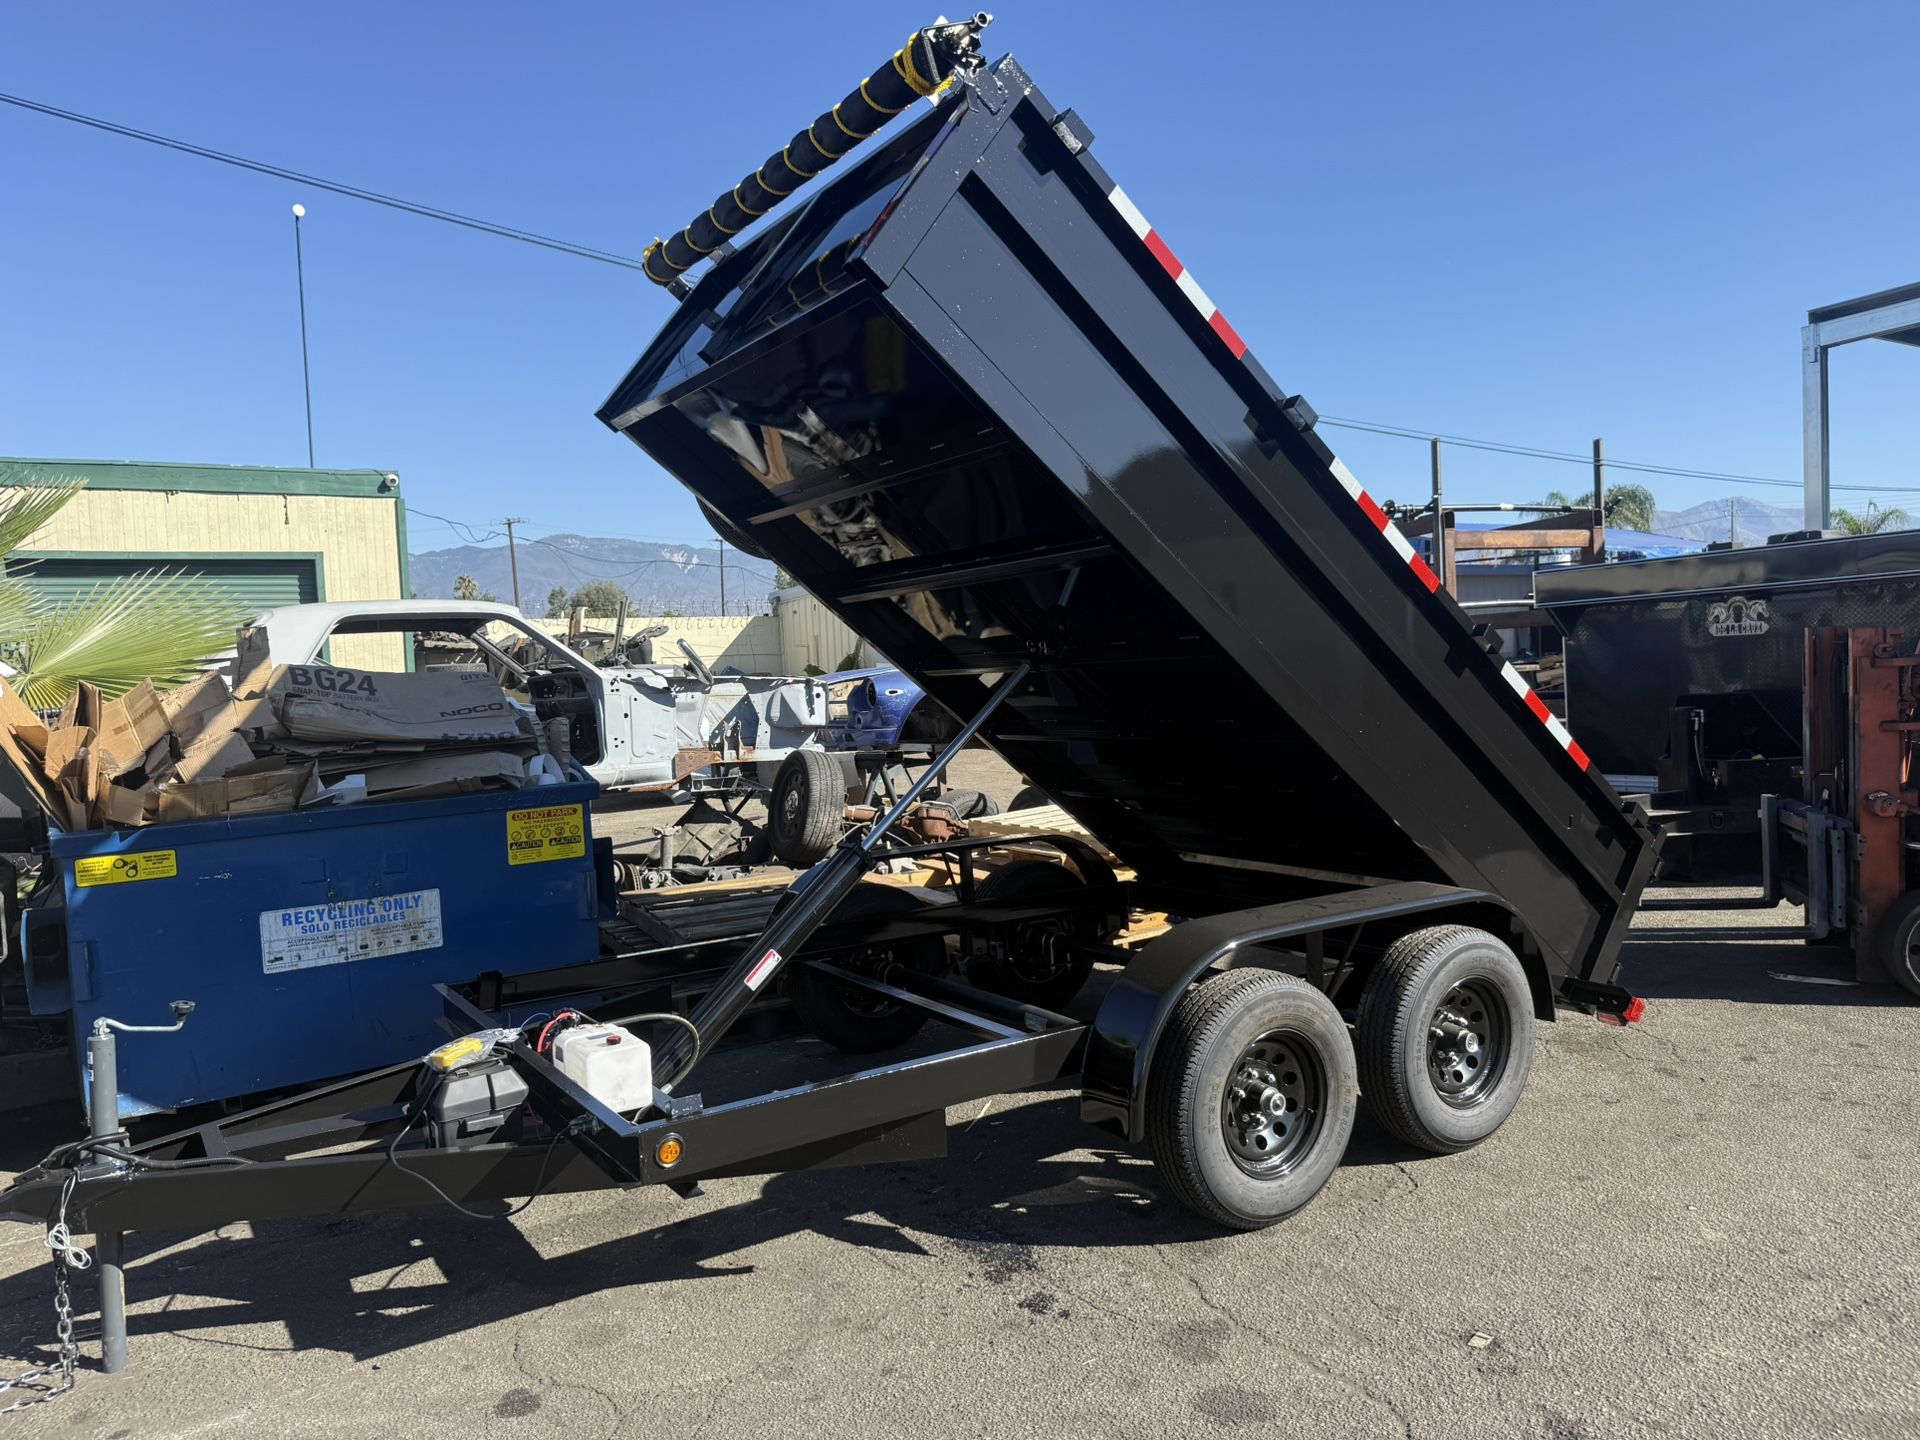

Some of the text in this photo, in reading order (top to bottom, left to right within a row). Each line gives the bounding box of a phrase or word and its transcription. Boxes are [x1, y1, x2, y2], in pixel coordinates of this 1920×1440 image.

[288, 667, 378, 696] BG24
[460, 673, 479, 681] QTY
[292, 686, 331, 698] SNAP-TOP
[439, 703, 504, 717] NOCO
[530, 811, 548, 819] NOT
[551, 808, 575, 816] PARK
[517, 840, 542, 849] CAUTION
[556, 836, 581, 845] CAUTION
[282, 894, 421, 926] RECYCLING ONLY
[301, 911, 405, 934] SOLO RECICLABLES
